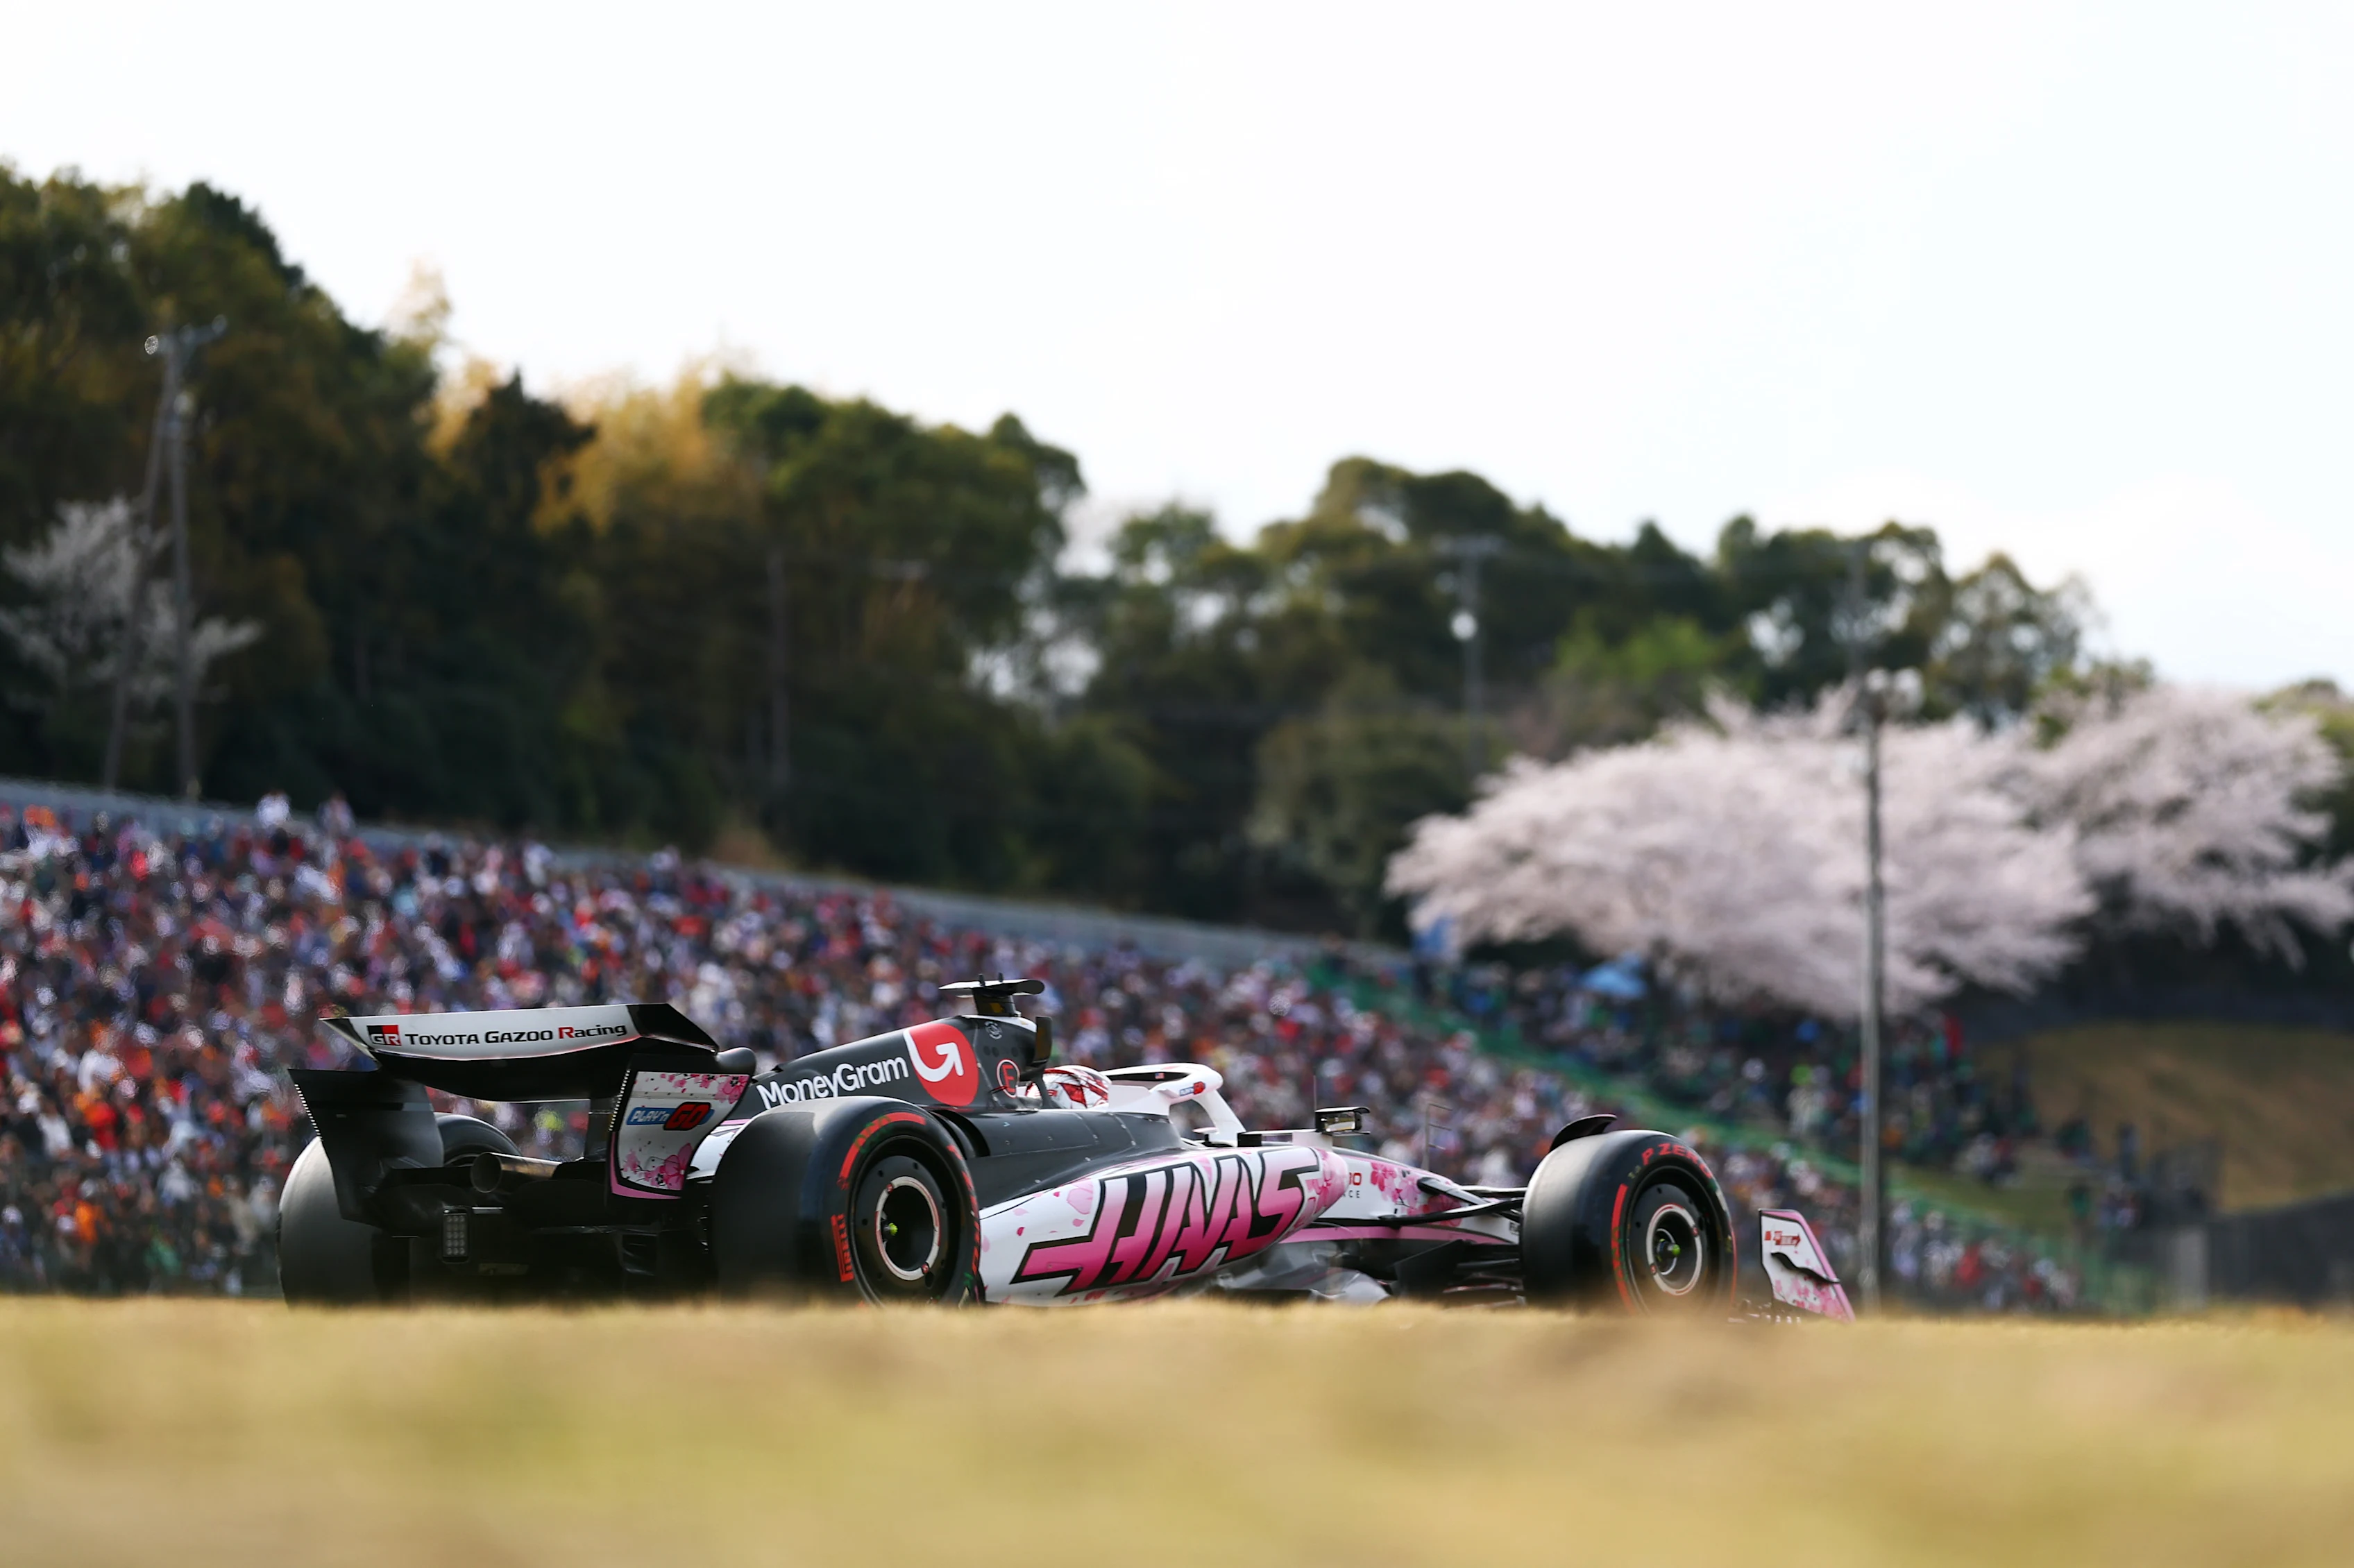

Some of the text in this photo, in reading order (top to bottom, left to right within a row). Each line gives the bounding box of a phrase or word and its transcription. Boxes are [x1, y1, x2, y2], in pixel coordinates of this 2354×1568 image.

[370, 1032, 402, 1046] GR
[405, 1025, 627, 1046] TOYOTA GAZOO Racing
[756, 1056, 909, 1111] MoneyGram
[664, 1102, 711, 1130] GO
[1641, 1147, 1654, 1166] P
[1658, 1143, 1713, 1179] ZERO
